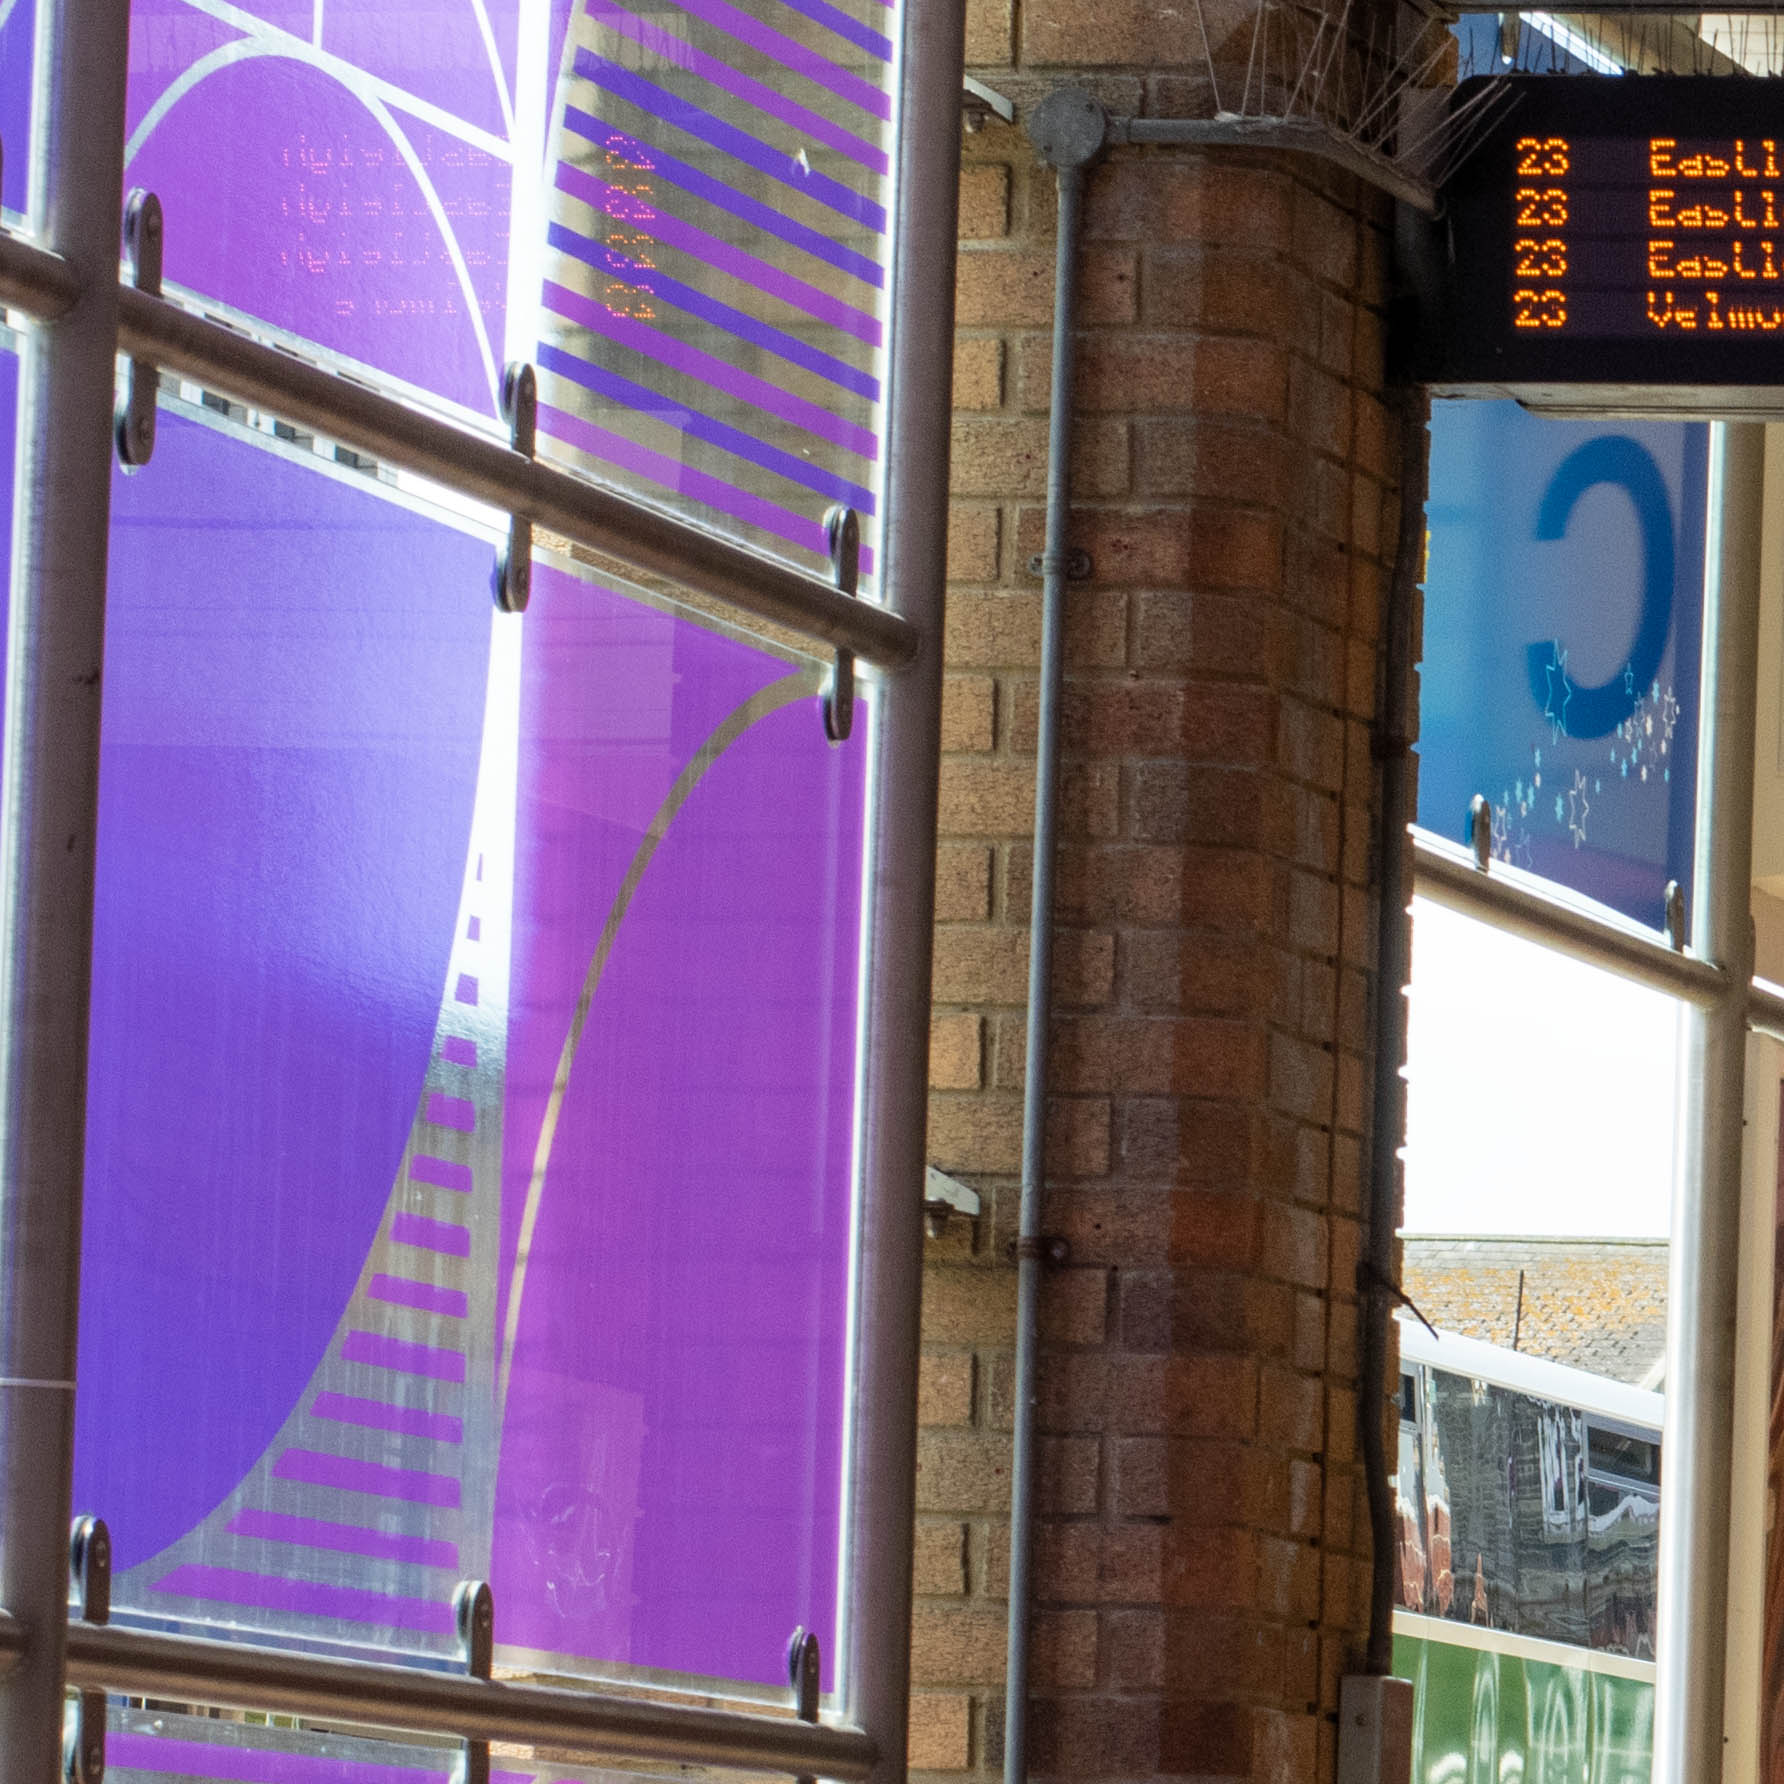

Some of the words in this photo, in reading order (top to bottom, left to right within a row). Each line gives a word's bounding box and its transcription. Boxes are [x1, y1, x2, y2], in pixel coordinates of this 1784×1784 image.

[1517, 138, 1569, 176] 23
[1516, 189, 1568, 226] 23
[1515, 239, 1567, 276] 23
[1514, 290, 1566, 327] 23
